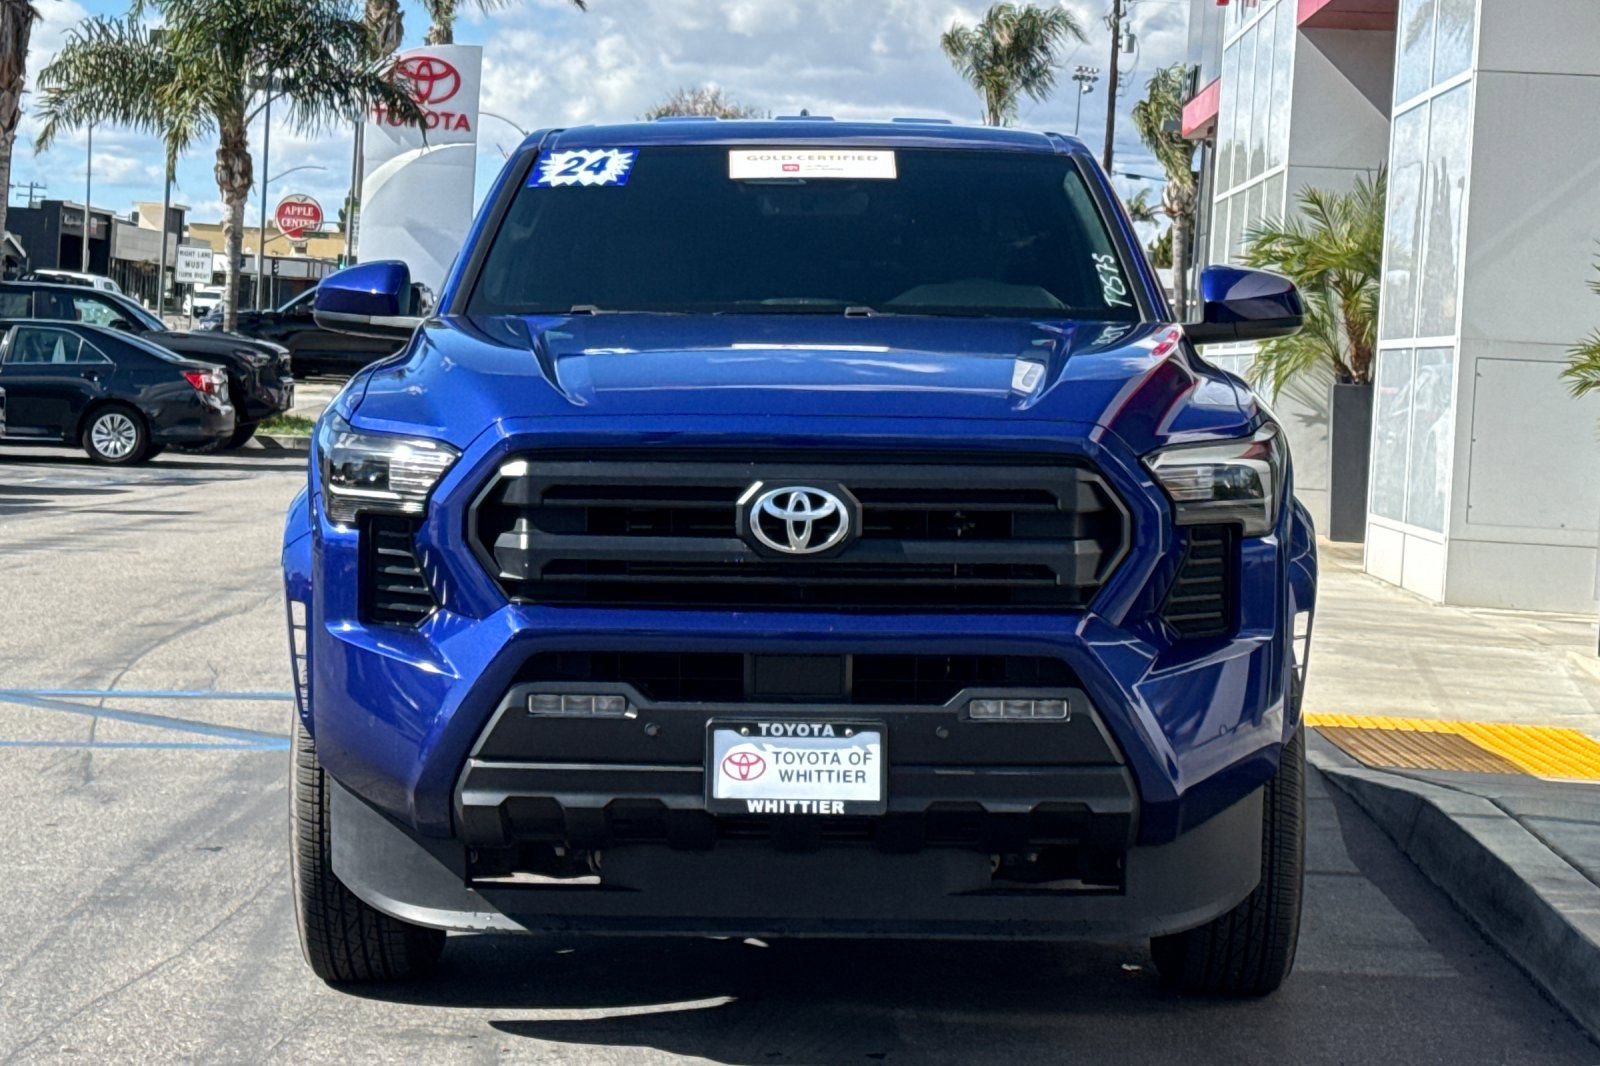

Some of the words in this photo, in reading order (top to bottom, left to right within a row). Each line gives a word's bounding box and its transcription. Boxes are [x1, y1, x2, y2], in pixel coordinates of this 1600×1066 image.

[555, 156, 611, 177] 24
[284, 206, 314, 217] APPLE
[185, 260, 205, 269] MUST
[757, 723, 836, 737] TOYOTA
[772, 751, 842, 766] TOYOTA
[848, 752, 873, 766] OF
[779, 769, 867, 784] WHITTIER
[747, 799, 845, 815] WHITTIER
